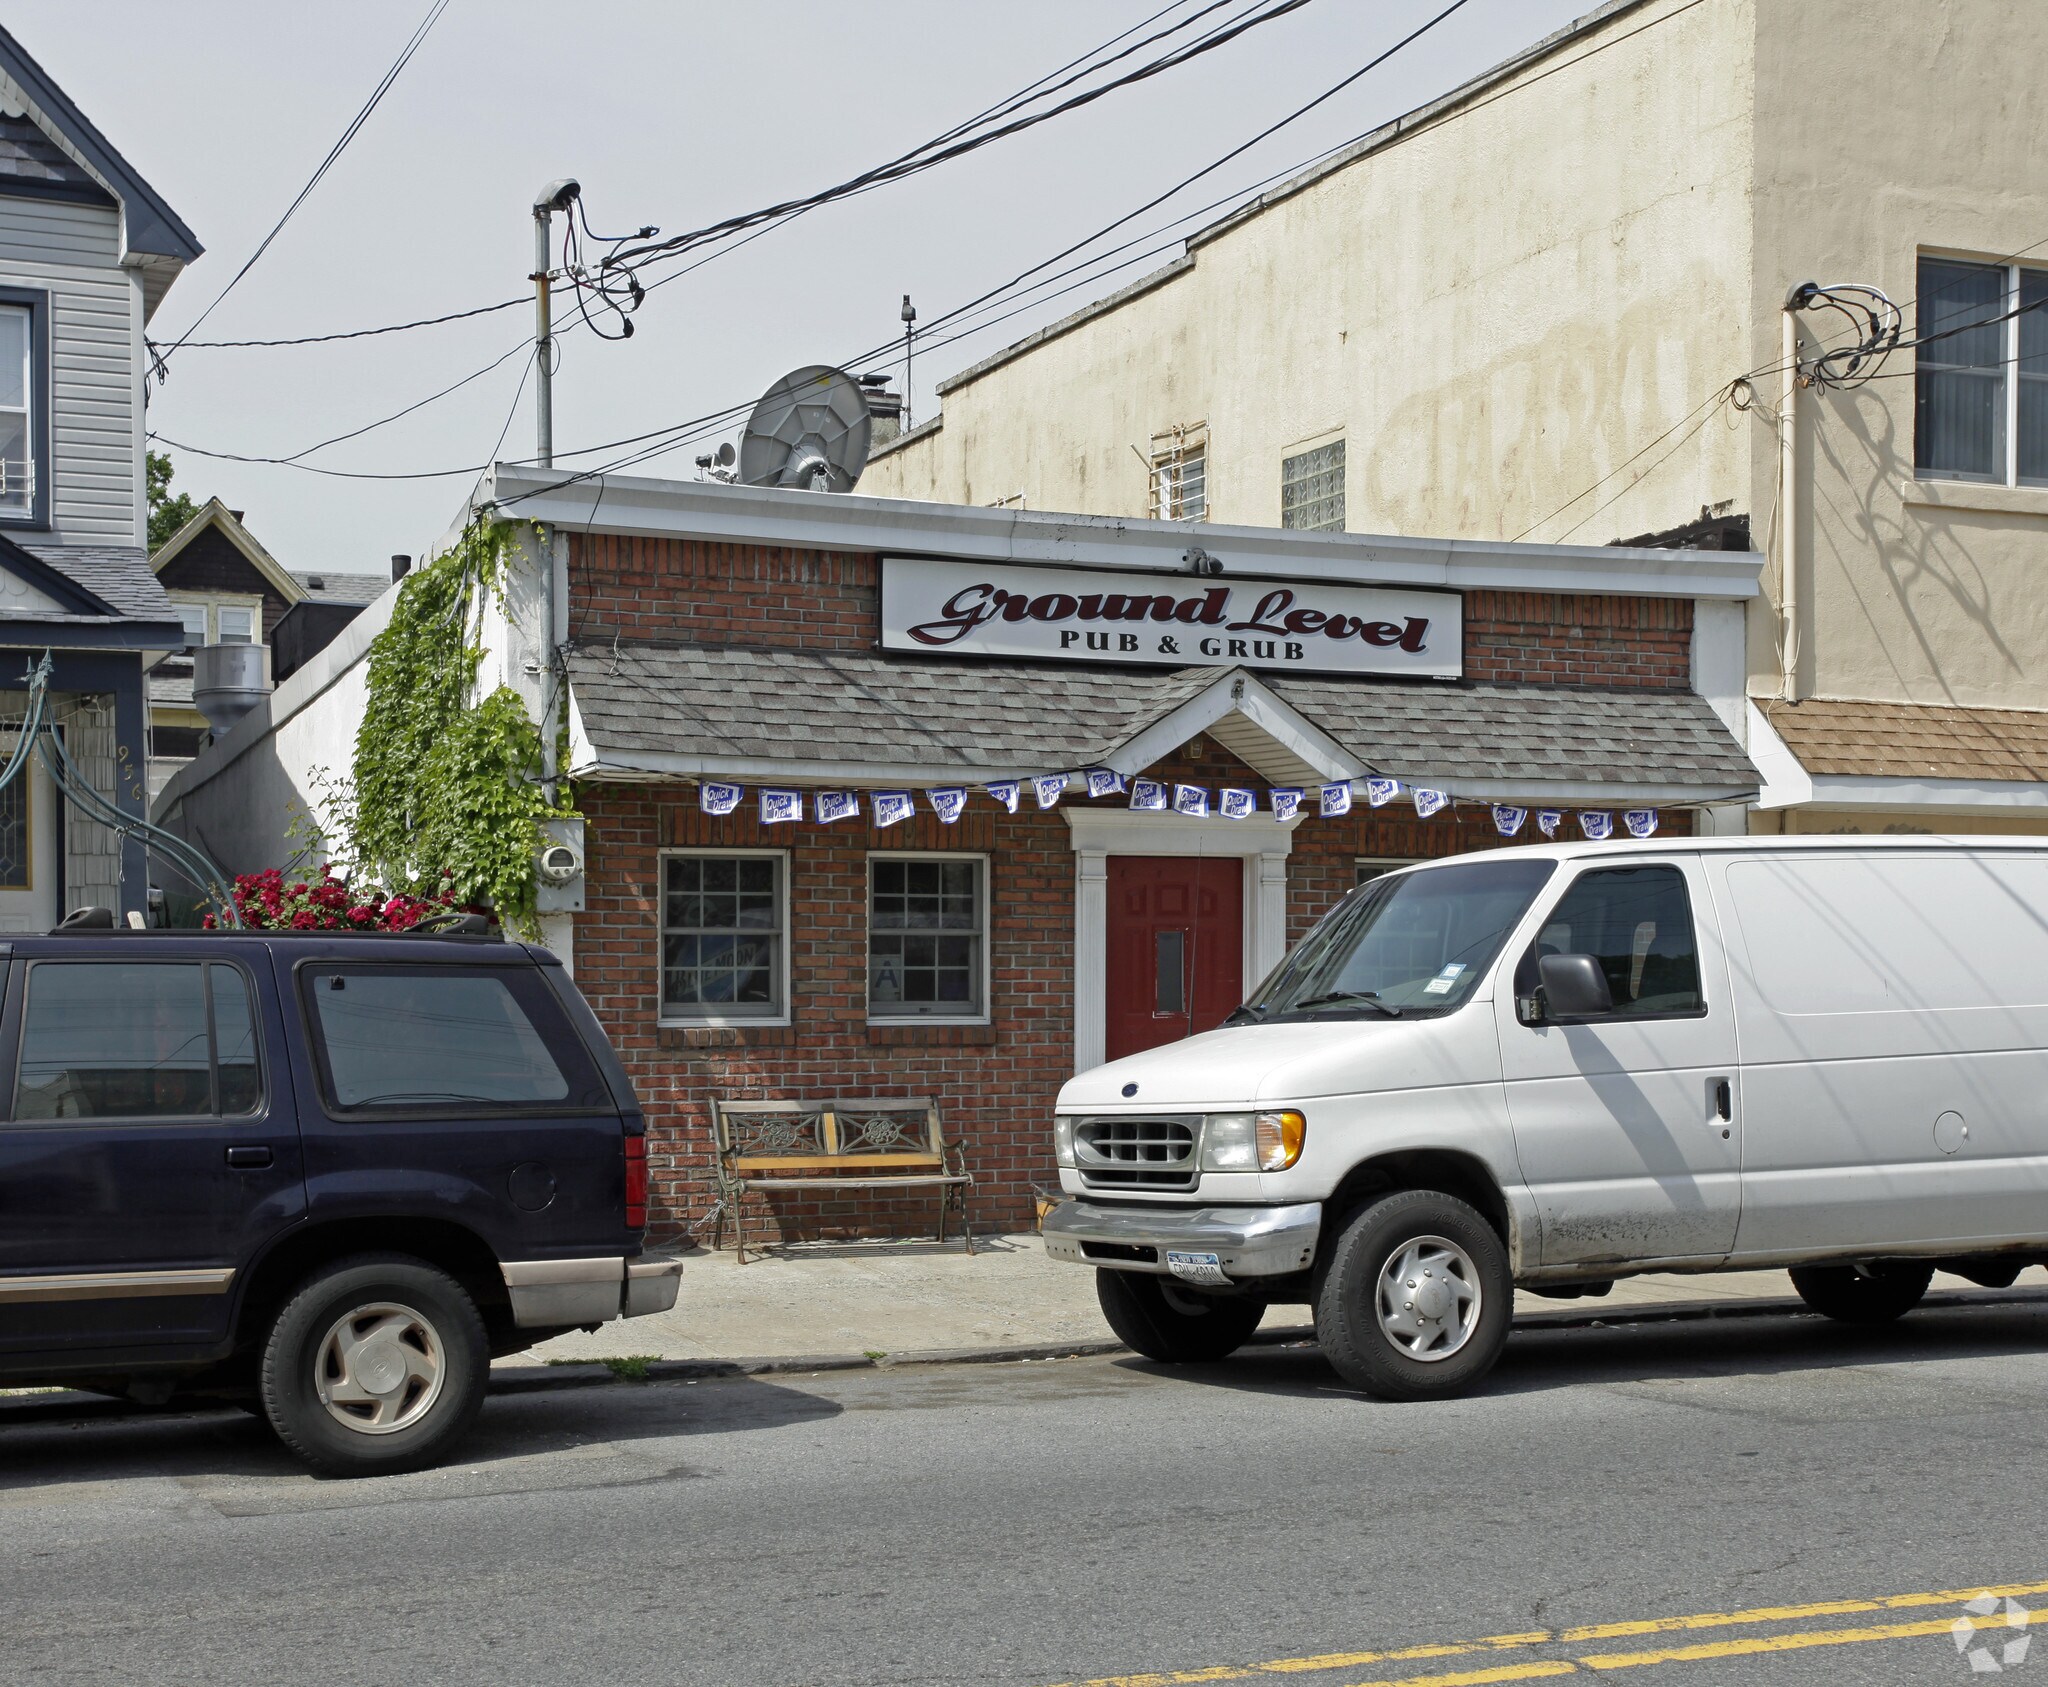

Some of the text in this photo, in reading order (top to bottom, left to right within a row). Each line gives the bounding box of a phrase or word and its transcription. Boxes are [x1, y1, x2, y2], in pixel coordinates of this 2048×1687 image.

[906, 583, 1430, 653] Ground Level
[1059, 630, 1305, 661] PUB & GRUB
[118, 745, 142, 801] 956
[1095, 772, 1112, 789] Quick
[708, 787, 729, 800] Quick
[1042, 780, 1060, 796] Quick
[1135, 784, 1154, 799] Quick
[1371, 781, 1390, 796] Quick
[991, 789, 1007, 801] uick
[1139, 794, 1157, 806] Draw
[1181, 790, 1200, 802] Quick
[1227, 794, 1245, 806] Quick
[1323, 789, 1341, 805] Quick
[1377, 791, 1395, 802] Draw
[1417, 792, 1436, 807] Quick
[713, 798, 733, 810] Draw
[767, 796, 788, 811] Quick
[823, 794, 843, 810] Quick
[880, 799, 899, 815] Quick
[935, 796, 955, 811] Quick
[1183, 801, 1201, 811] Draw
[1276, 796, 1294, 811] Quick
[1329, 799, 1346, 812] Draw
[1424, 801, 1443, 813] Draw
[773, 807, 793, 819] Draw
[830, 804, 849, 817] Draw
[886, 809, 905, 822] Draw
[941, 805, 960, 818] Draw
[1230, 804, 1247, 815] Draw
[1281, 805, 1298, 818] Draw
[1496, 808, 1514, 820] Quick
[1499, 818, 1515, 829] Draw
[1584, 816, 1601, 828] Quick
[1629, 814, 1646, 826] Quick
[1588, 825, 1604, 835] Draw
[1634, 823, 1650, 833] Draw
[714, 948, 754, 977] MOON
[875, 960, 898, 988] A
